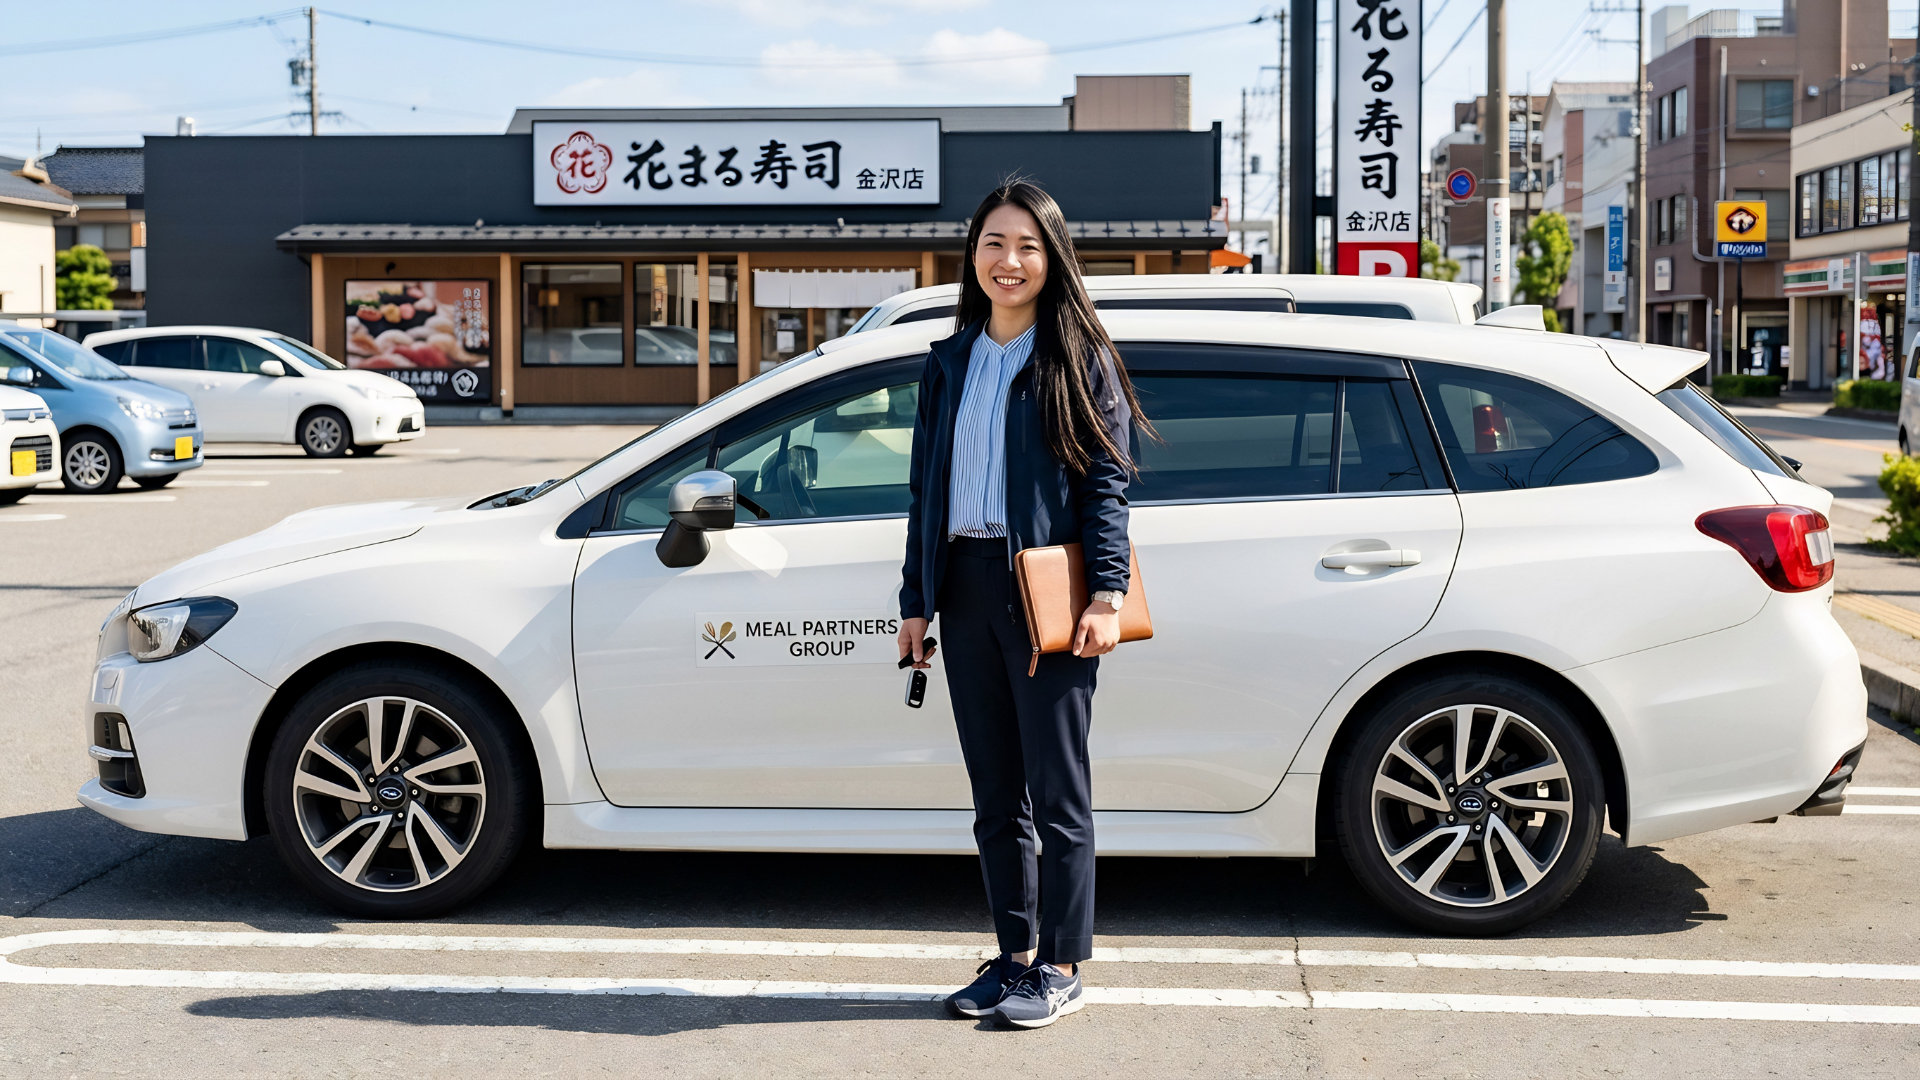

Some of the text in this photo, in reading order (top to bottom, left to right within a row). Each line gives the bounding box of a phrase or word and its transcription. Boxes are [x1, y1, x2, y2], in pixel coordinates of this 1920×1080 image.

[567, 148, 596, 178] 花
[623, 139, 924, 190] 花まる寿司 金沢店
[1345, 211, 1412, 232] 金沢店
[746, 619, 898, 637] MEAL PARTNERS
[789, 641, 855, 656] GROUP
